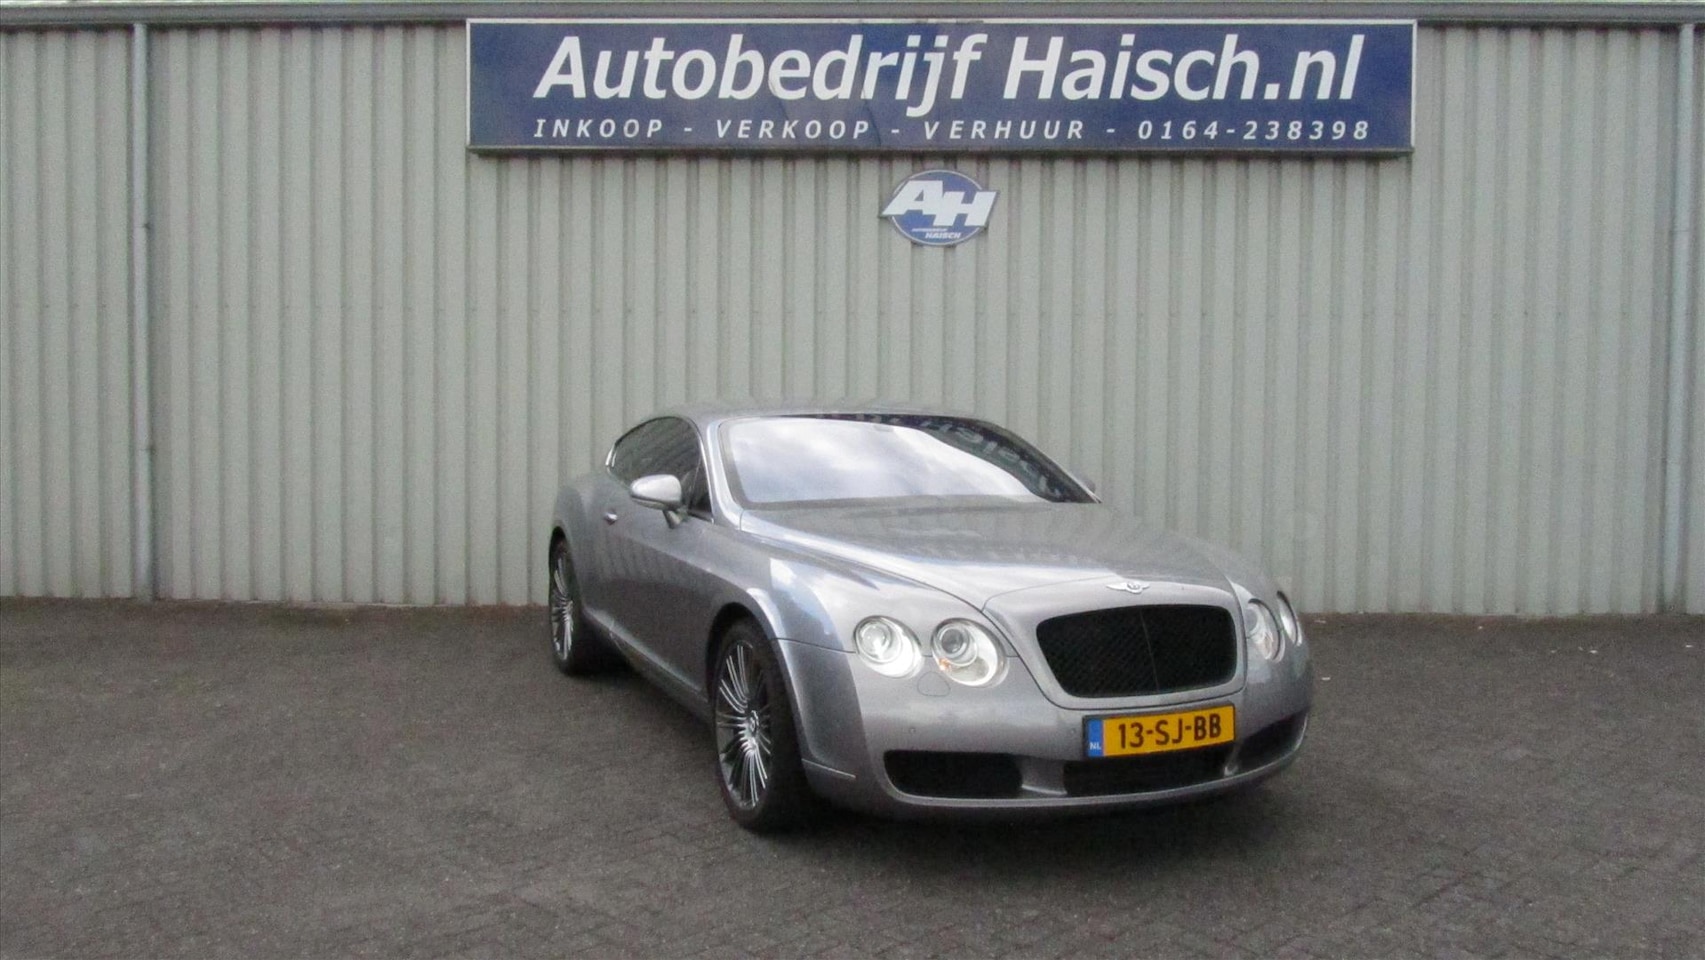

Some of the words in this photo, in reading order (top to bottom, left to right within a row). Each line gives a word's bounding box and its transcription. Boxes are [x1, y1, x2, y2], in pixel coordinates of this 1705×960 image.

[533, 33, 988, 117] Autobedrijf
[1003, 33, 1365, 100] Haisch.nl
[533, 118, 663, 139] INKOOP
[716, 119, 870, 139] VERKOOP
[923, 120, 1085, 140] VERHUUR
[1138, 120, 1370, 140] 0164-238398
[881, 180, 997, 226] AH
[1089, 742, 1101, 750] NL
[1118, 713, 1222, 749] 13-SJ-BB
